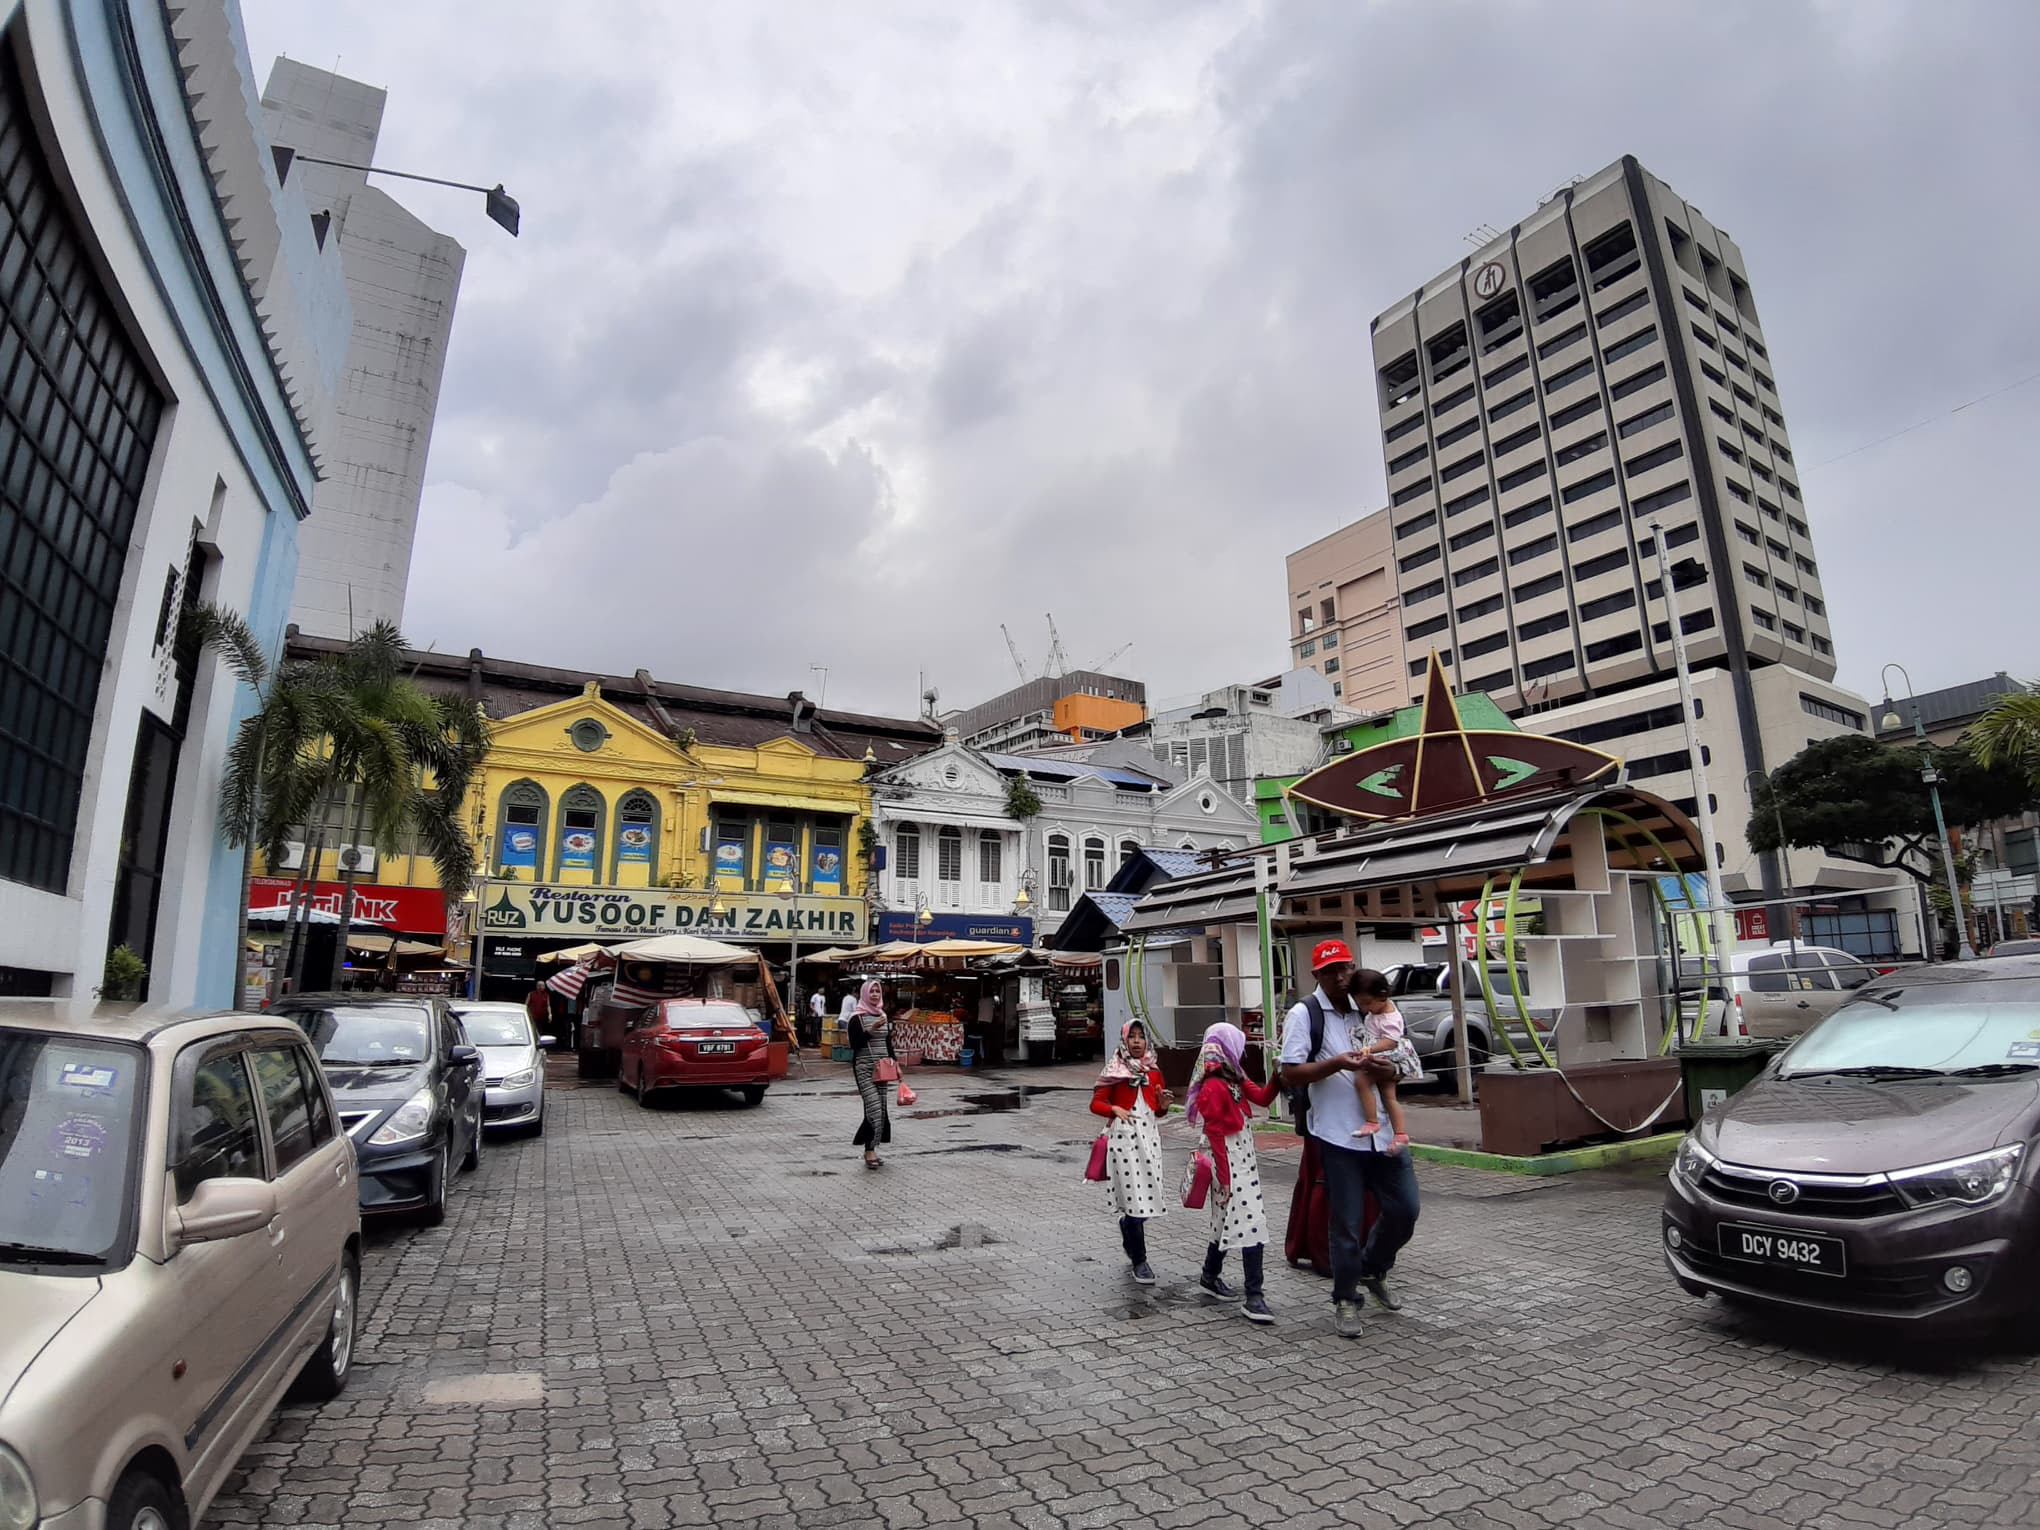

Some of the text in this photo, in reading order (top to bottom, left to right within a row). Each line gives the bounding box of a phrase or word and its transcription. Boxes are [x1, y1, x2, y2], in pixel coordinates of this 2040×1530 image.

[277, 889, 399, 922] HTLNK
[529, 888, 632, 902] Restoran
[529, 900, 856, 931] YUSOOF DAN ZAKHIR
[969, 926, 1010, 936] guardian
[1742, 1233, 1821, 1264] DCY 9432
